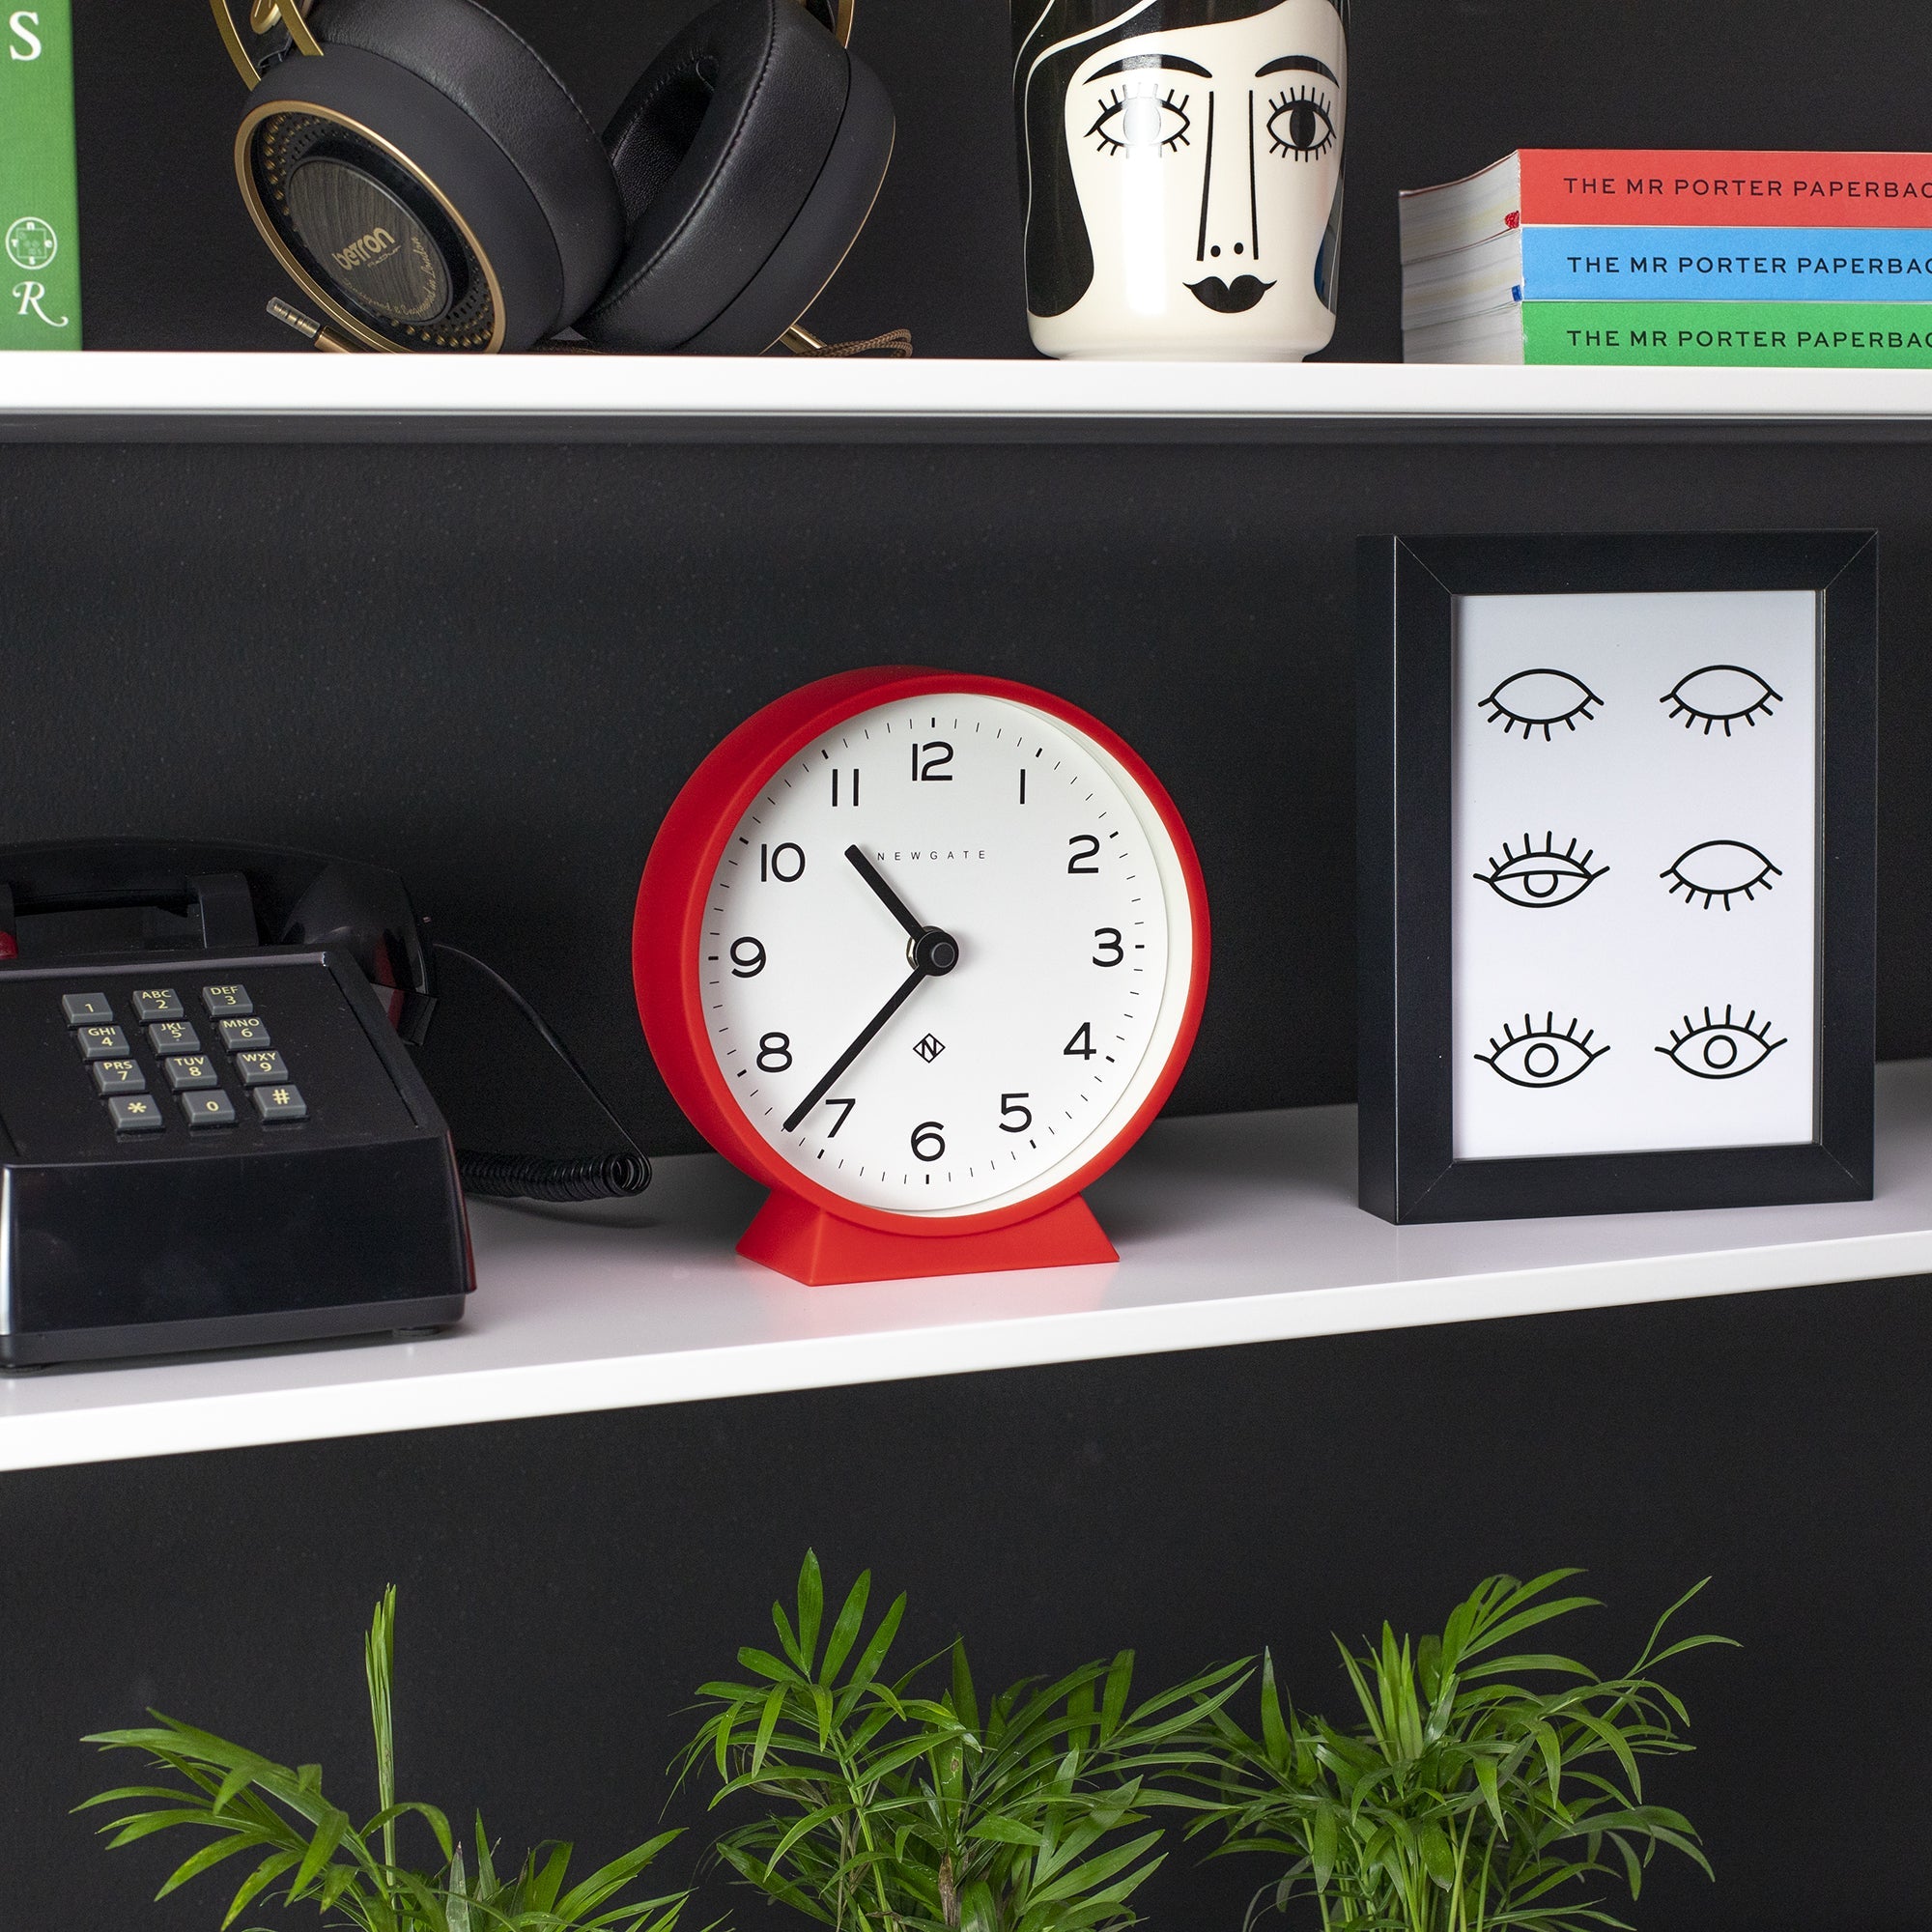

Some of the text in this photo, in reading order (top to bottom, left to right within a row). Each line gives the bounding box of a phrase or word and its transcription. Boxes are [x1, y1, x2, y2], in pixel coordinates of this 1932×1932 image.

[9, 11, 42, 61] S
[1563, 178, 1616, 194] THE
[1627, 178, 1663, 195] MR
[1674, 179, 1782, 197] PORTER
[1567, 256, 1620, 273] THE
[1631, 257, 1667, 273] MR
[1679, 256, 1787, 273] PORTER
[12, 281, 69, 327] R
[1566, 330, 1620, 347] THE
[1630, 330, 1667, 347] MR
[1678, 330, 1786, 348] PORTER
[911, 741, 954, 781] 12
[832, 768, 860, 808] 11
[1019, 768, 1026, 805] 1
[876, 850, 986, 861] NEWGATE
[1067, 834, 1100, 874] 2
[760, 841, 806, 883] 10
[1092, 926, 1124, 968] 3
[729, 936, 767, 979] 9
[142, 989, 172, 1000] ABC
[210, 985, 239, 996] DEF
[157, 1000, 169, 1009] 2
[224, 995, 237, 1006] 3
[85, 1003, 95, 1013] 1
[160, 1022, 186, 1032] JKL
[223, 1018, 260, 1029] MNO
[88, 1026, 116, 1037] GHI
[172, 1029, 183, 1039] 5
[242, 1028, 254, 1038] 6
[101, 1037, 113, 1047] 4
[1063, 1021, 1097, 1061] 4
[242, 1051, 276, 1062] WXY
[755, 1032, 793, 1073] 8
[103, 1061, 133, 1071] PRS
[174, 1056, 205, 1066] TUV
[260, 1062, 272, 1072] 9
[117, 1070, 128, 1081] 7
[189, 1066, 202, 1077] 8
[206, 1100, 219, 1113] 0
[825, 1097, 856, 1139] 7
[998, 1093, 1033, 1133] 5
[910, 1121, 946, 1162] 6
